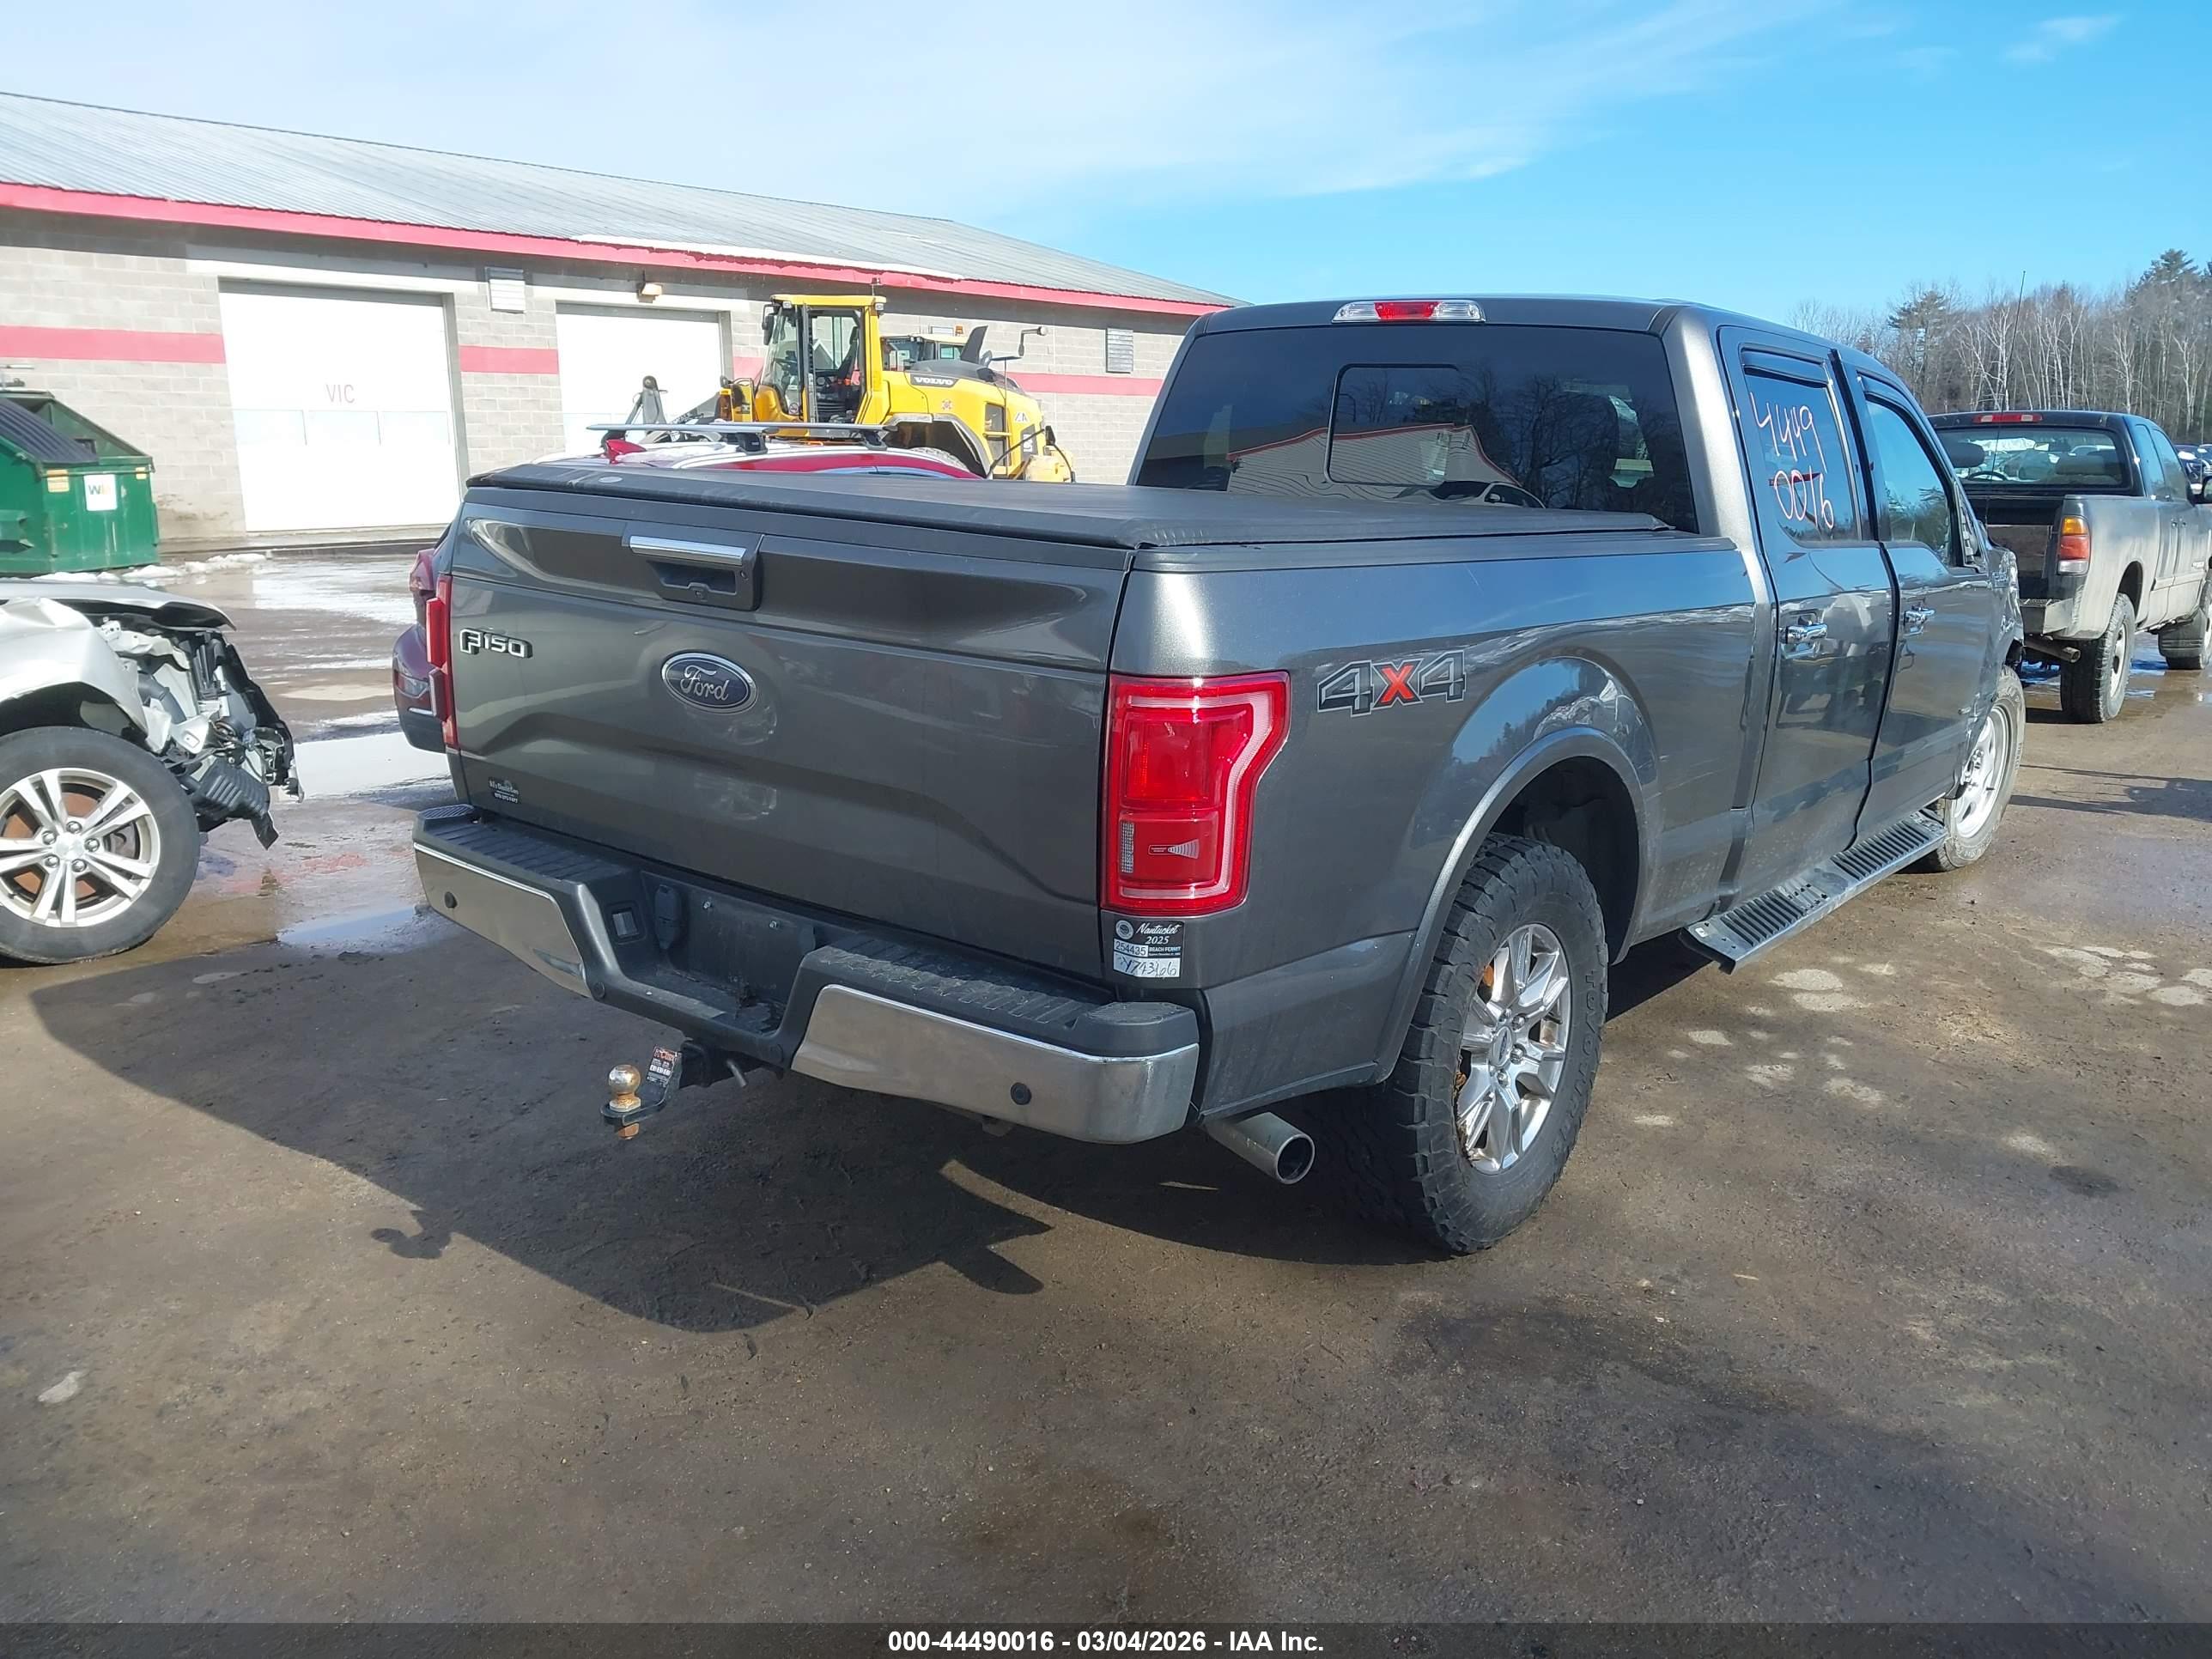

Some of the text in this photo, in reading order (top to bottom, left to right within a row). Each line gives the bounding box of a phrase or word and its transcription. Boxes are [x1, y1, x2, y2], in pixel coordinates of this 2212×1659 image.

[914, 376, 954, 386] VOLVO
[325, 383, 356, 404] VIC
[1749, 391, 1829, 475] 4449
[1773, 465, 1835, 530] 0016
[679, 664, 731, 702] Ford
[1135, 922, 1182, 935] Nantucket
[1115, 940, 1147, 957] 254435
[1145, 935, 1170, 945] 2025
